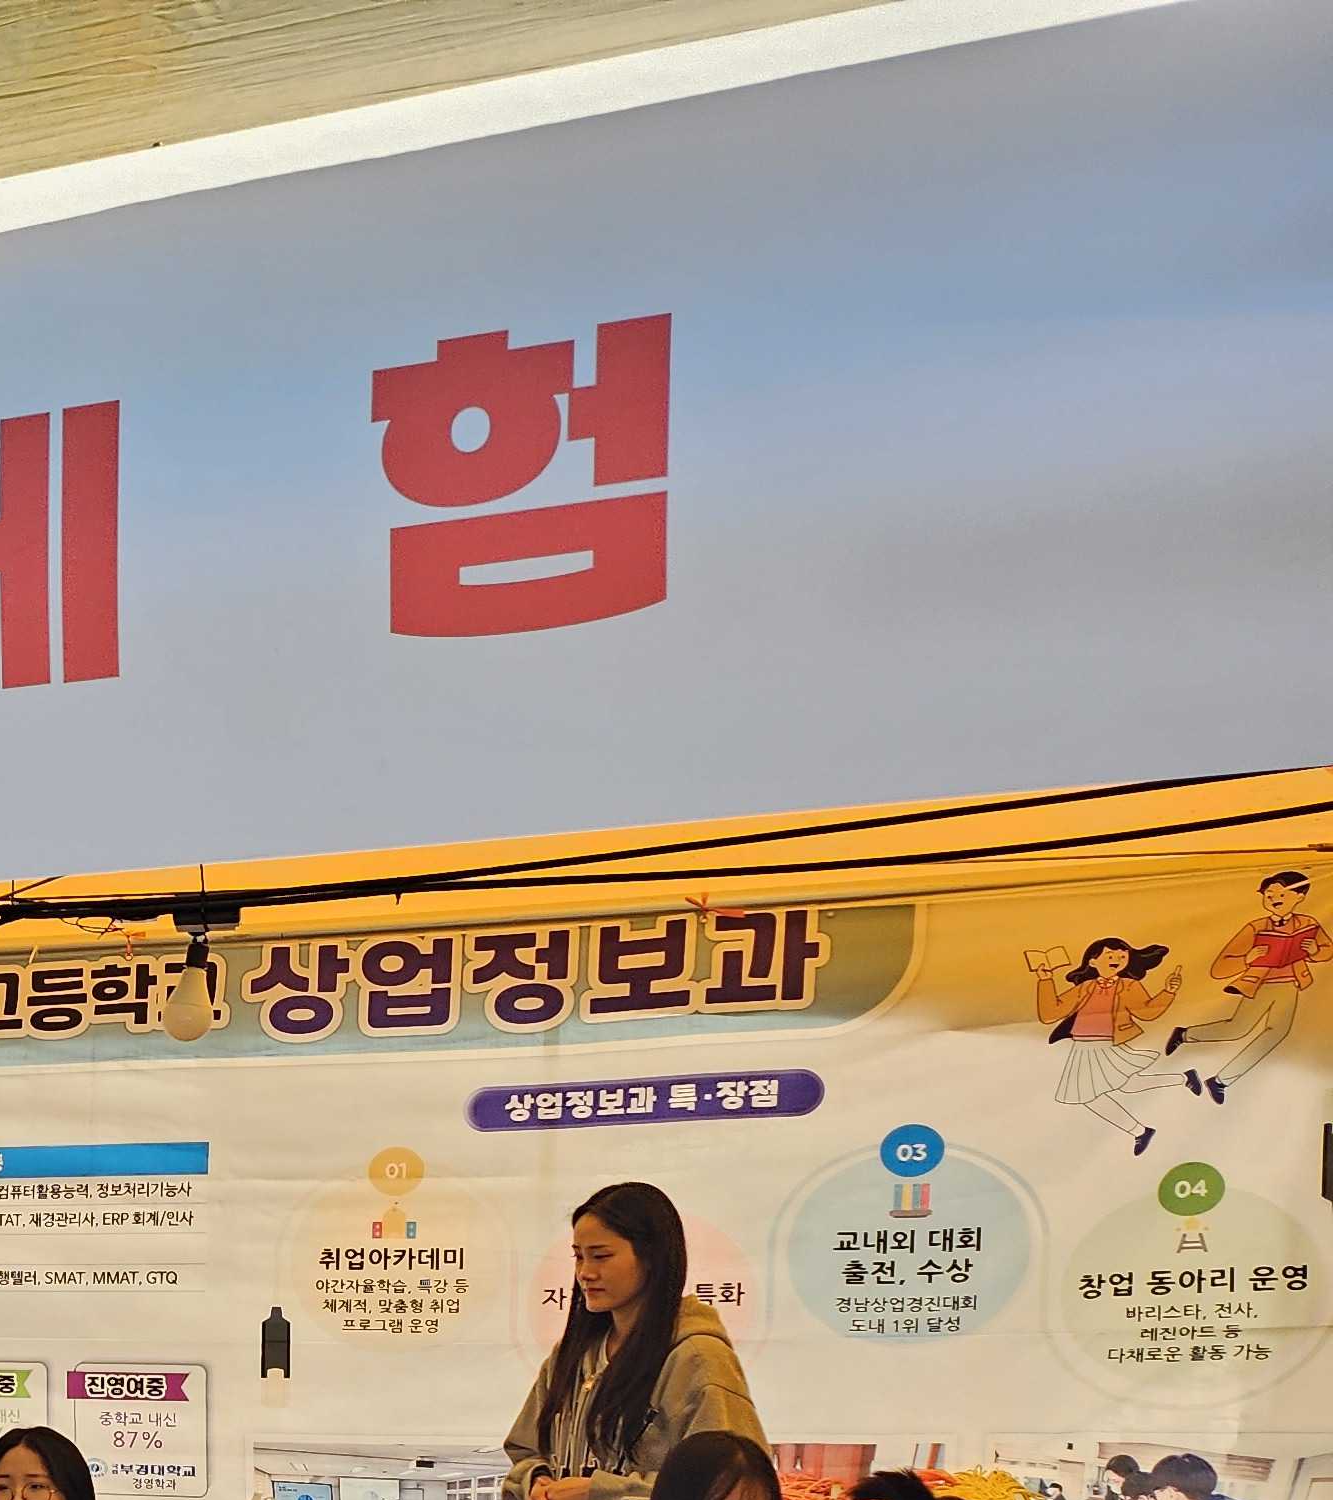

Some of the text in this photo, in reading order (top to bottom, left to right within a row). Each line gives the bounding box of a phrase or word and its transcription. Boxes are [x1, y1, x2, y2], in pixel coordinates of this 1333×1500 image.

[251, 912, 821, 1036] 상업정보과
[504, 1087, 657, 1123] 상업정보과
[896, 1143, 928, 1162] 03
[385, 1162, 407, 1179] 01
[96, 1181, 192, 1199] 정보처리기능사
[1174, 1179, 1208, 1198] 04
[29, 1212, 99, 1228] 재경관리사,
[102, 1212, 130, 1226] ERP
[132, 1210, 194, 1227] 회계/인사
[832, 1226, 982, 1255] 교내외 대회
[318, 1247, 465, 1271] 취업아카데미
[44, 1271, 89, 1286] SMAT,
[92, 1271, 142, 1286] MMAT,
[146, 1271, 178, 1286] GTQ
[841, 1257, 974, 1286] 출전, 수상
[315, 1278, 470, 1295] 야간자율학습, 특강 등
[1078, 1264, 1308, 1300] 창업 동아리 운영
[695, 1282, 746, 1307] 특화
[835, 1294, 978, 1313] 경남상업경진대회
[321, 1298, 460, 1314] 체계적, 맞춤형 취업
[1125, 1301, 1259, 1322] 바리스타, 전사,
[341, 1318, 439, 1334] 프로그램 운영
[848, 1316, 962, 1335] 도내 1위 달성
[1140, 1324, 1243, 1342] 레진아드 등
[1107, 1343, 1273, 1364] 다채로운 활동 가능
[86, 1375, 167, 1398] 진영여중
[98, 1411, 178, 1428] 중학교 내신
[112, 1430, 164, 1450] 87%
[132, 1478, 177, 1491] 경영학과
